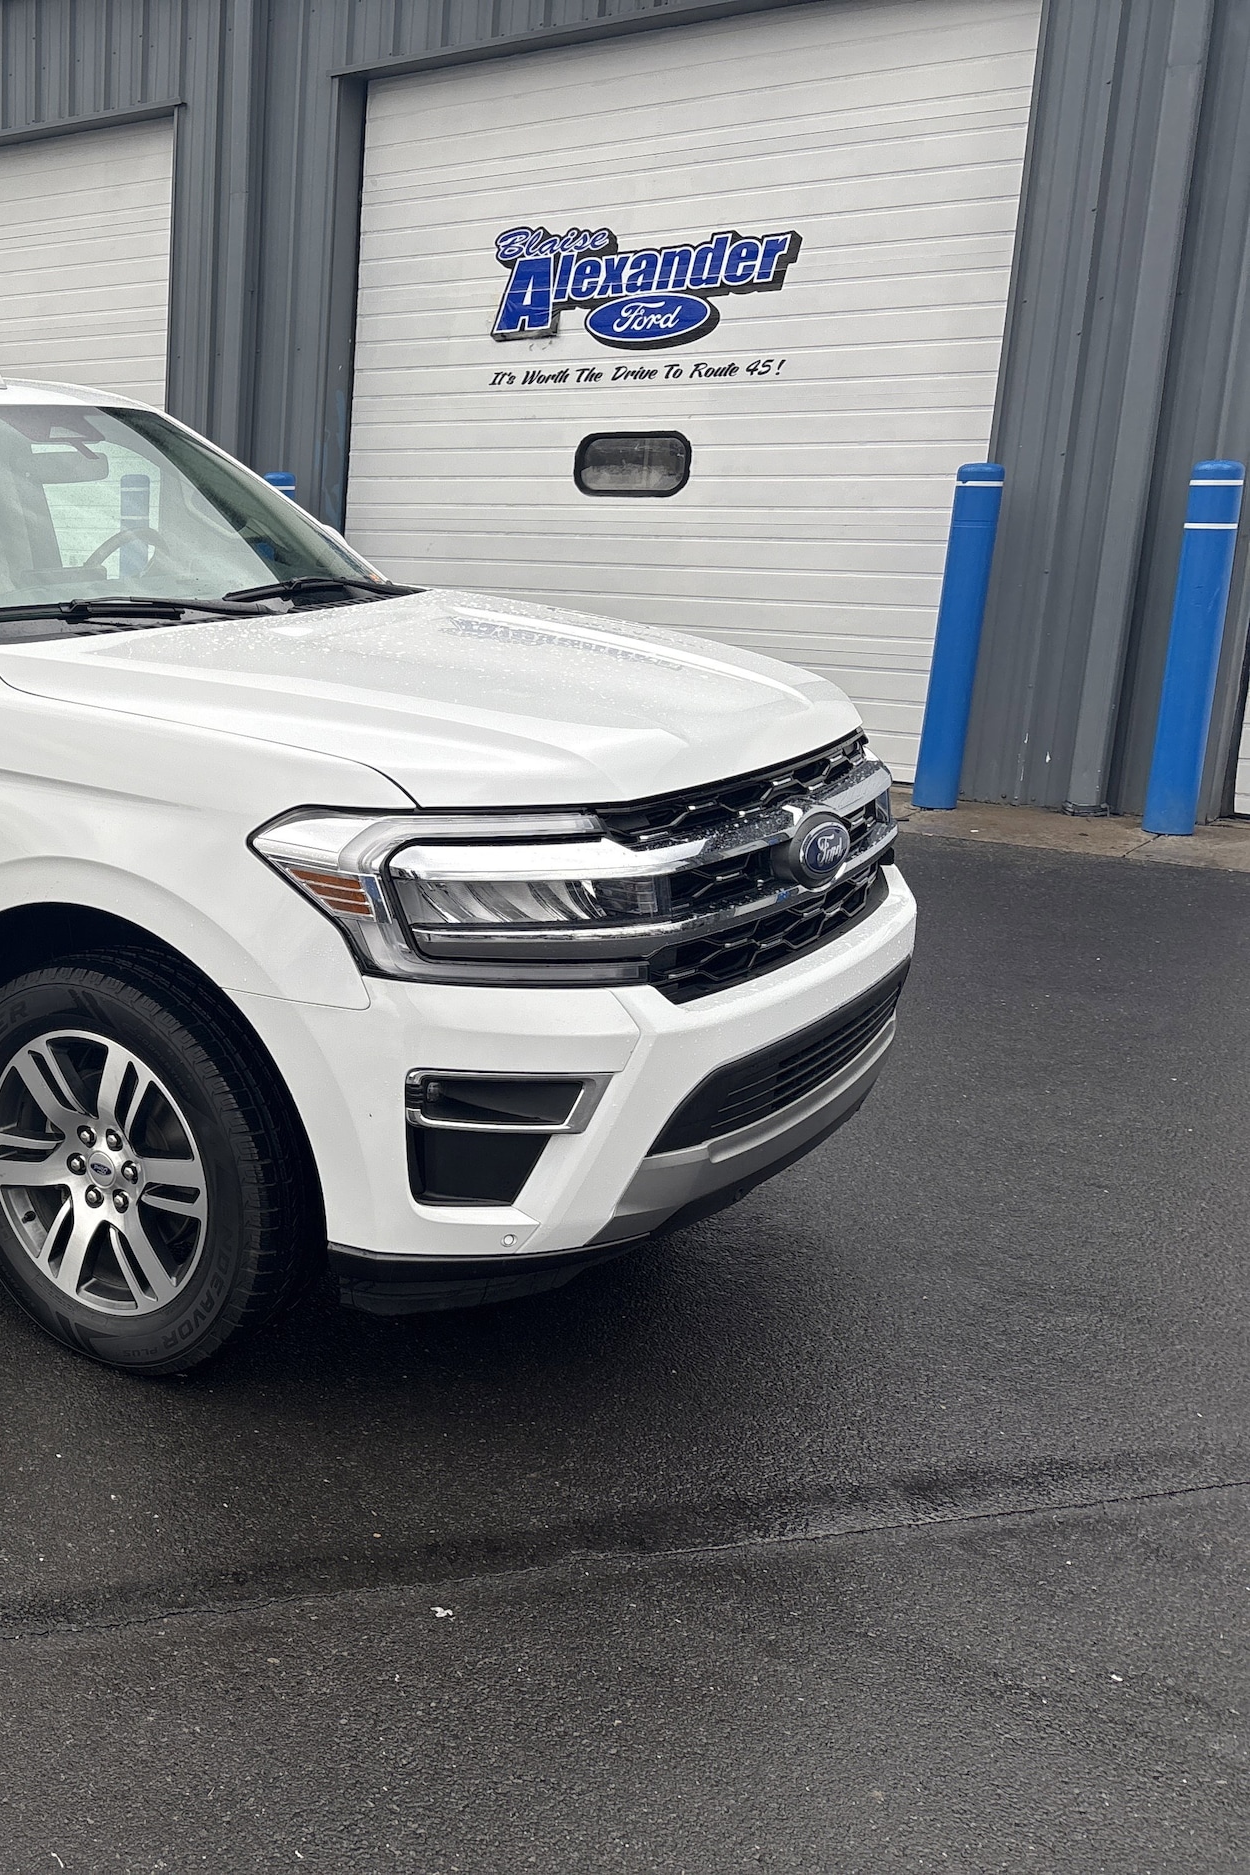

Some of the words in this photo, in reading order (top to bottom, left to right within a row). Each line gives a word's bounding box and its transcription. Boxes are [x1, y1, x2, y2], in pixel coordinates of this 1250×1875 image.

[497, 228, 610, 260] Blaise
[493, 232, 794, 334] Alexander
[612, 300, 682, 332] Ford
[488, 371, 516, 386] It's
[521, 368, 570, 385] Worth
[576, 367, 603, 383] The
[611, 366, 658, 381] Drive
[664, 363, 683, 379] To
[689, 362, 740, 379] Route
[817, 833, 844, 865] Ford
[122, 1345, 159, 1358] PLUS
